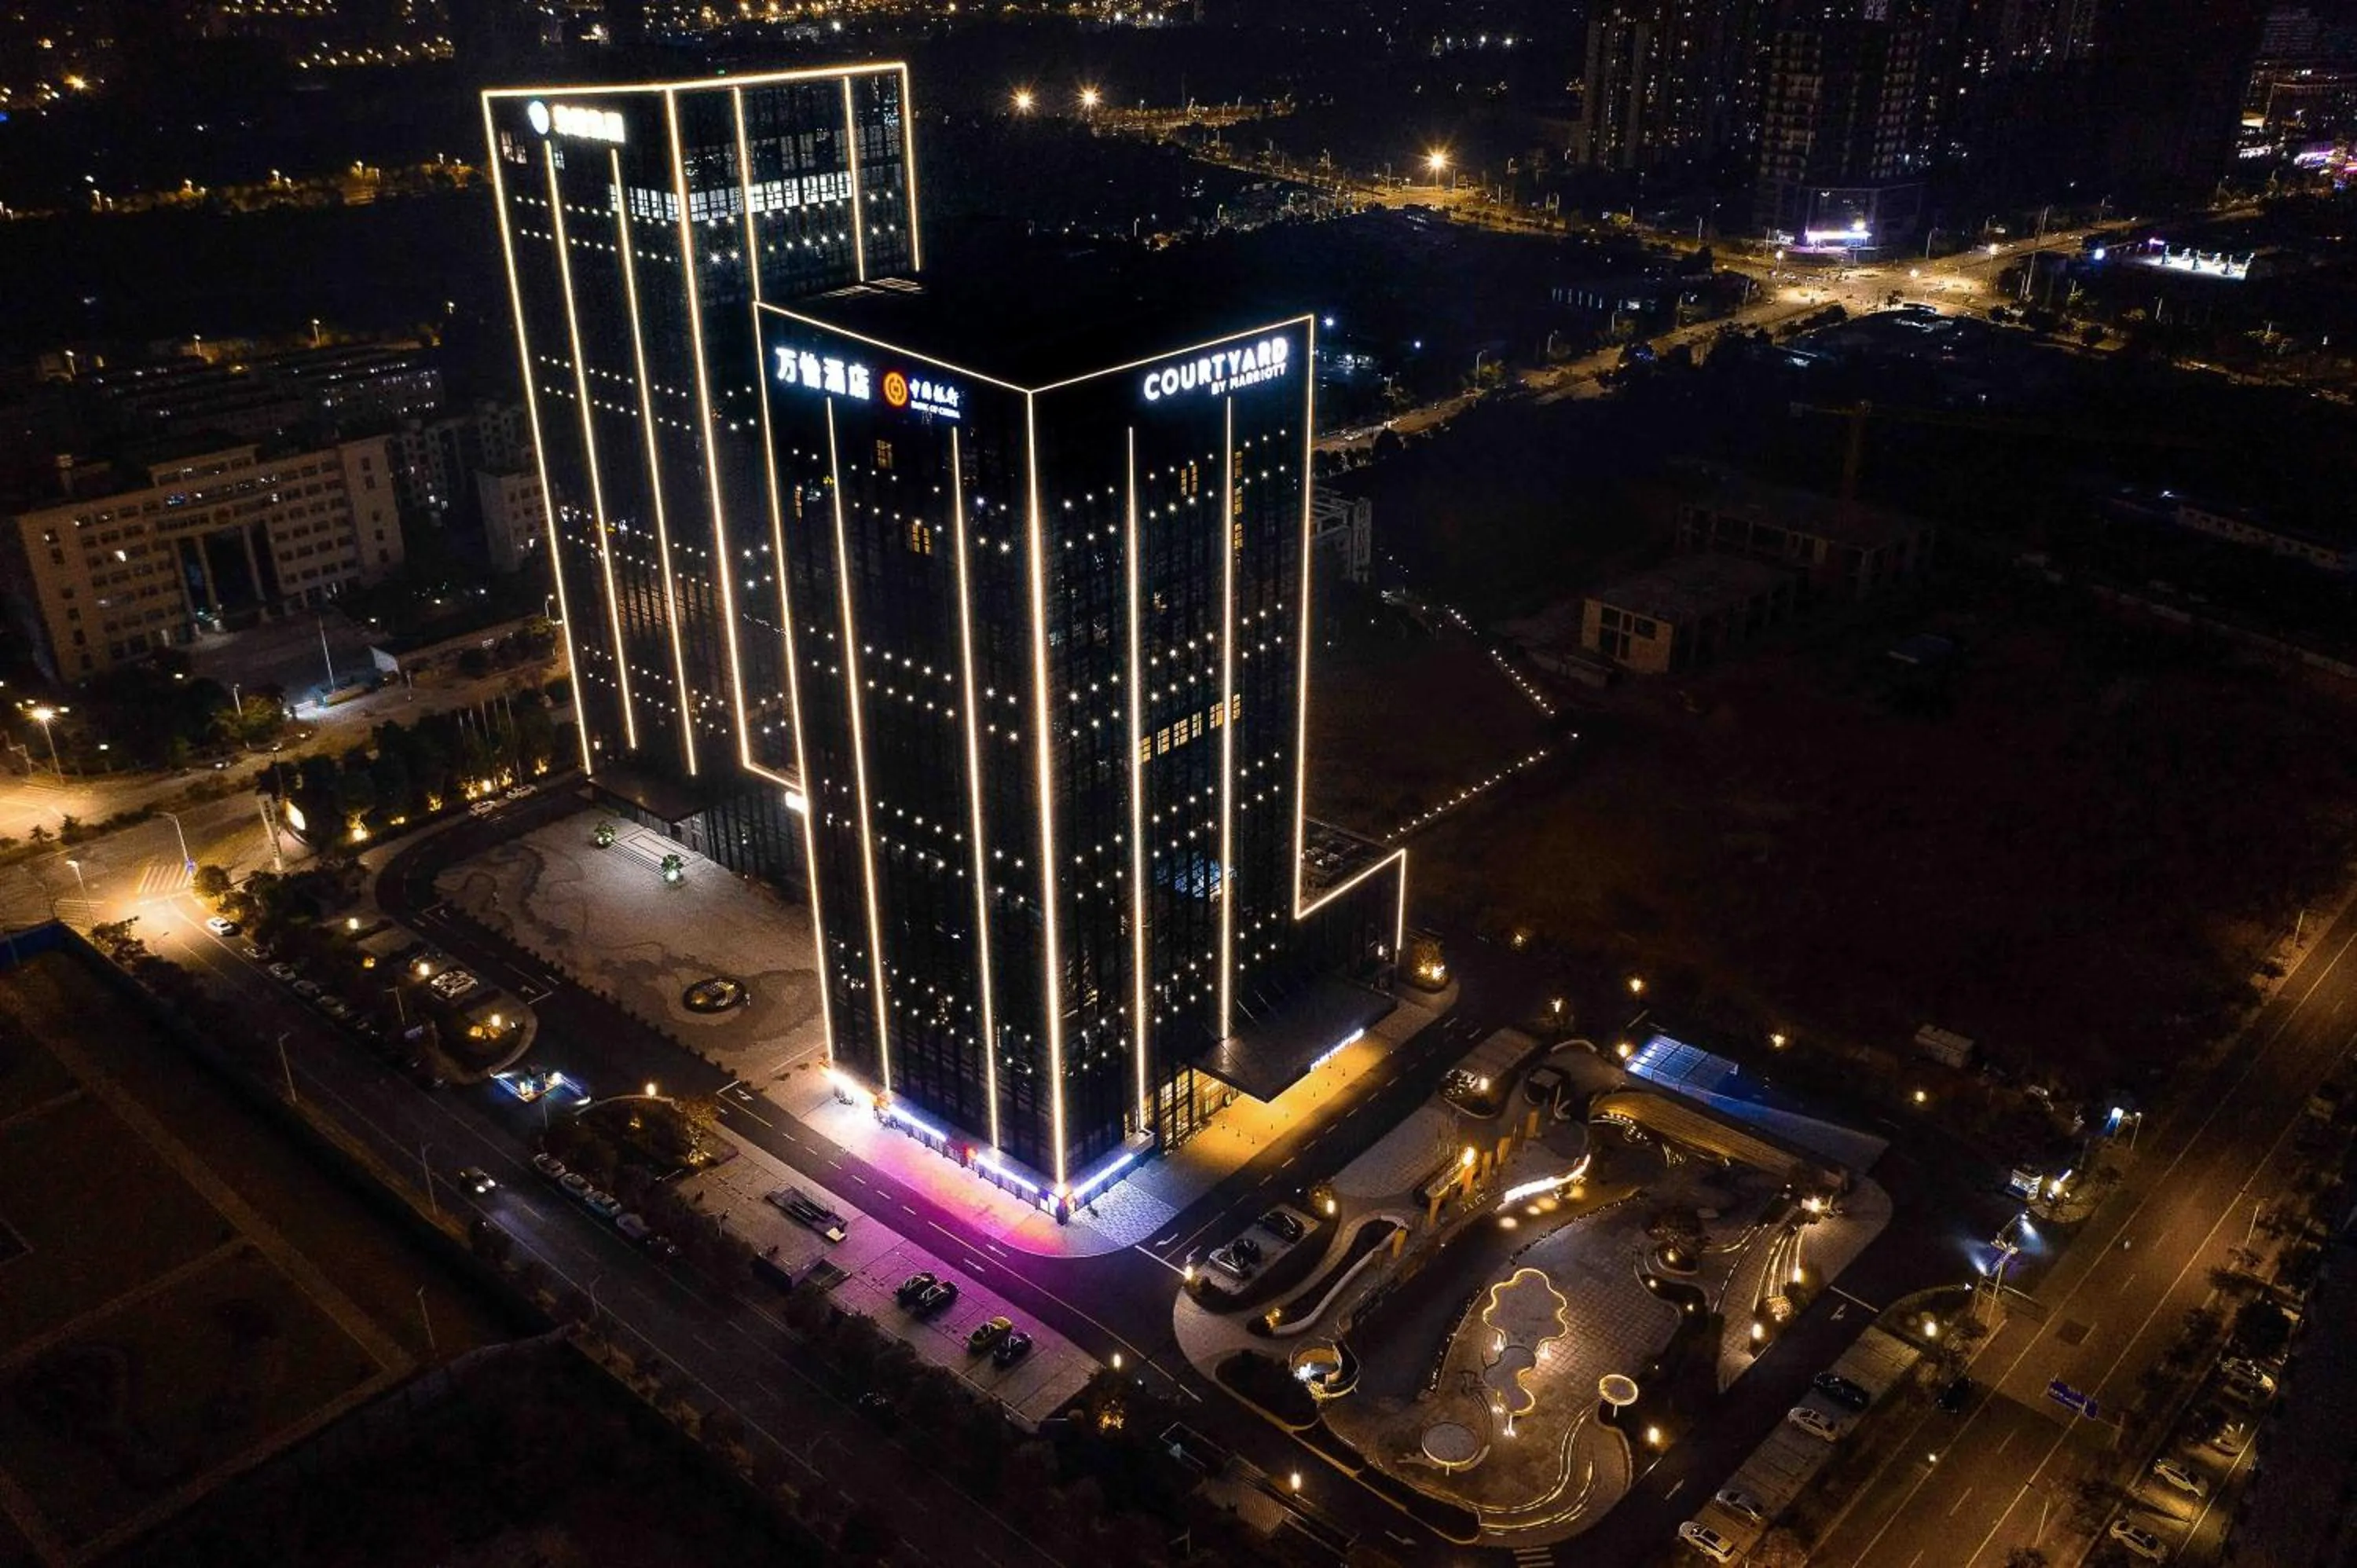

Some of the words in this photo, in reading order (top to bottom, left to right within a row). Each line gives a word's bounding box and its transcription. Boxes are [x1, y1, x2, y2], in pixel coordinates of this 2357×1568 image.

[775, 346, 870, 400] 万怡酒店
[1144, 337, 1288, 401] COURTYARD
[1211, 379, 1226, 395] BY
[1230, 363, 1287, 390] MARRIOTT
